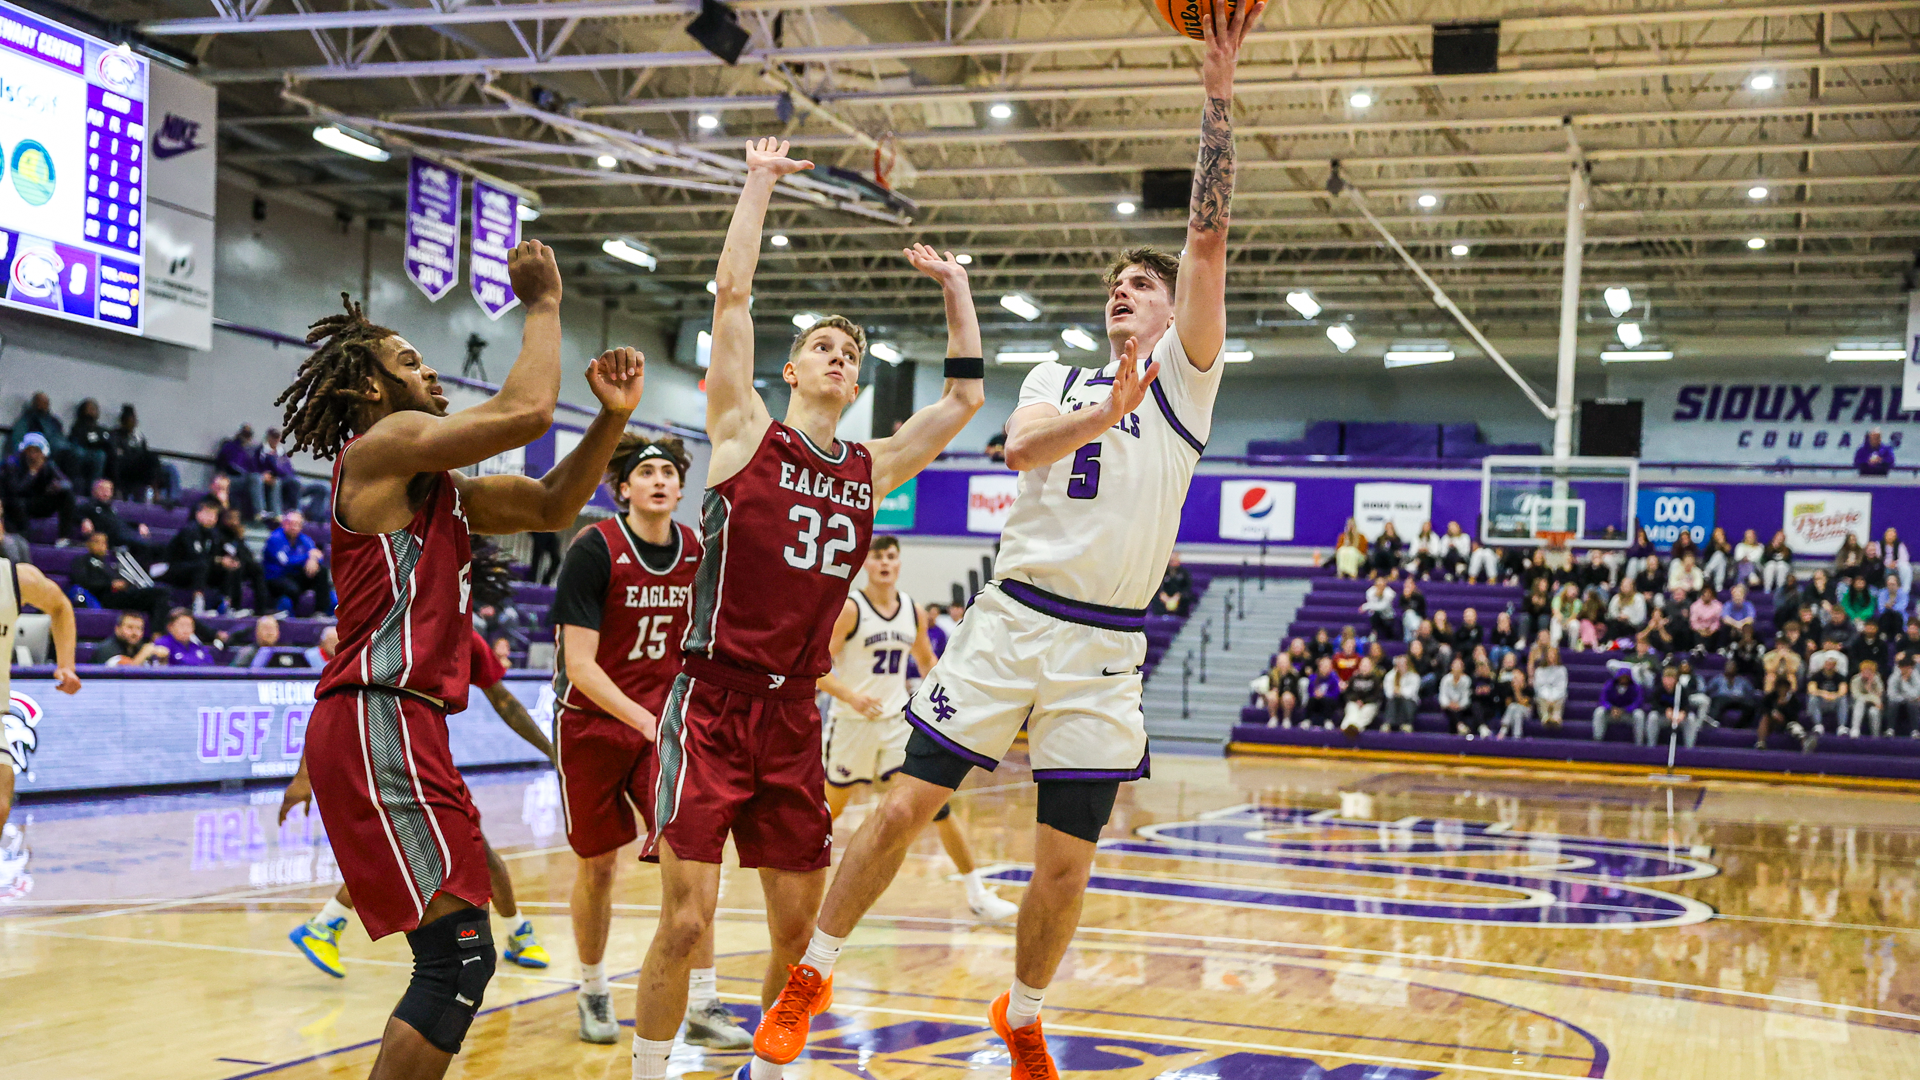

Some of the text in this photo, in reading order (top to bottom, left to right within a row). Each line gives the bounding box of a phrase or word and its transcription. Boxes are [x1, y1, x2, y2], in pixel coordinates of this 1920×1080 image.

[1181, 0, 1204, 39] Wils
[37, 32, 82, 67] CENTER
[1673, 384, 1920, 422] SIOUX FAL
[1738, 430, 1903, 449] COUGAS
[779, 461, 871, 510] EAGLES
[1067, 442, 1102, 499] 5
[783, 503, 857, 579] 32
[625, 585, 688, 608] EAGLES
[627, 615, 673, 660] 15
[872, 650, 902, 674] 20
[929, 683, 957, 723] USF
[197, 706, 275, 763] USF
